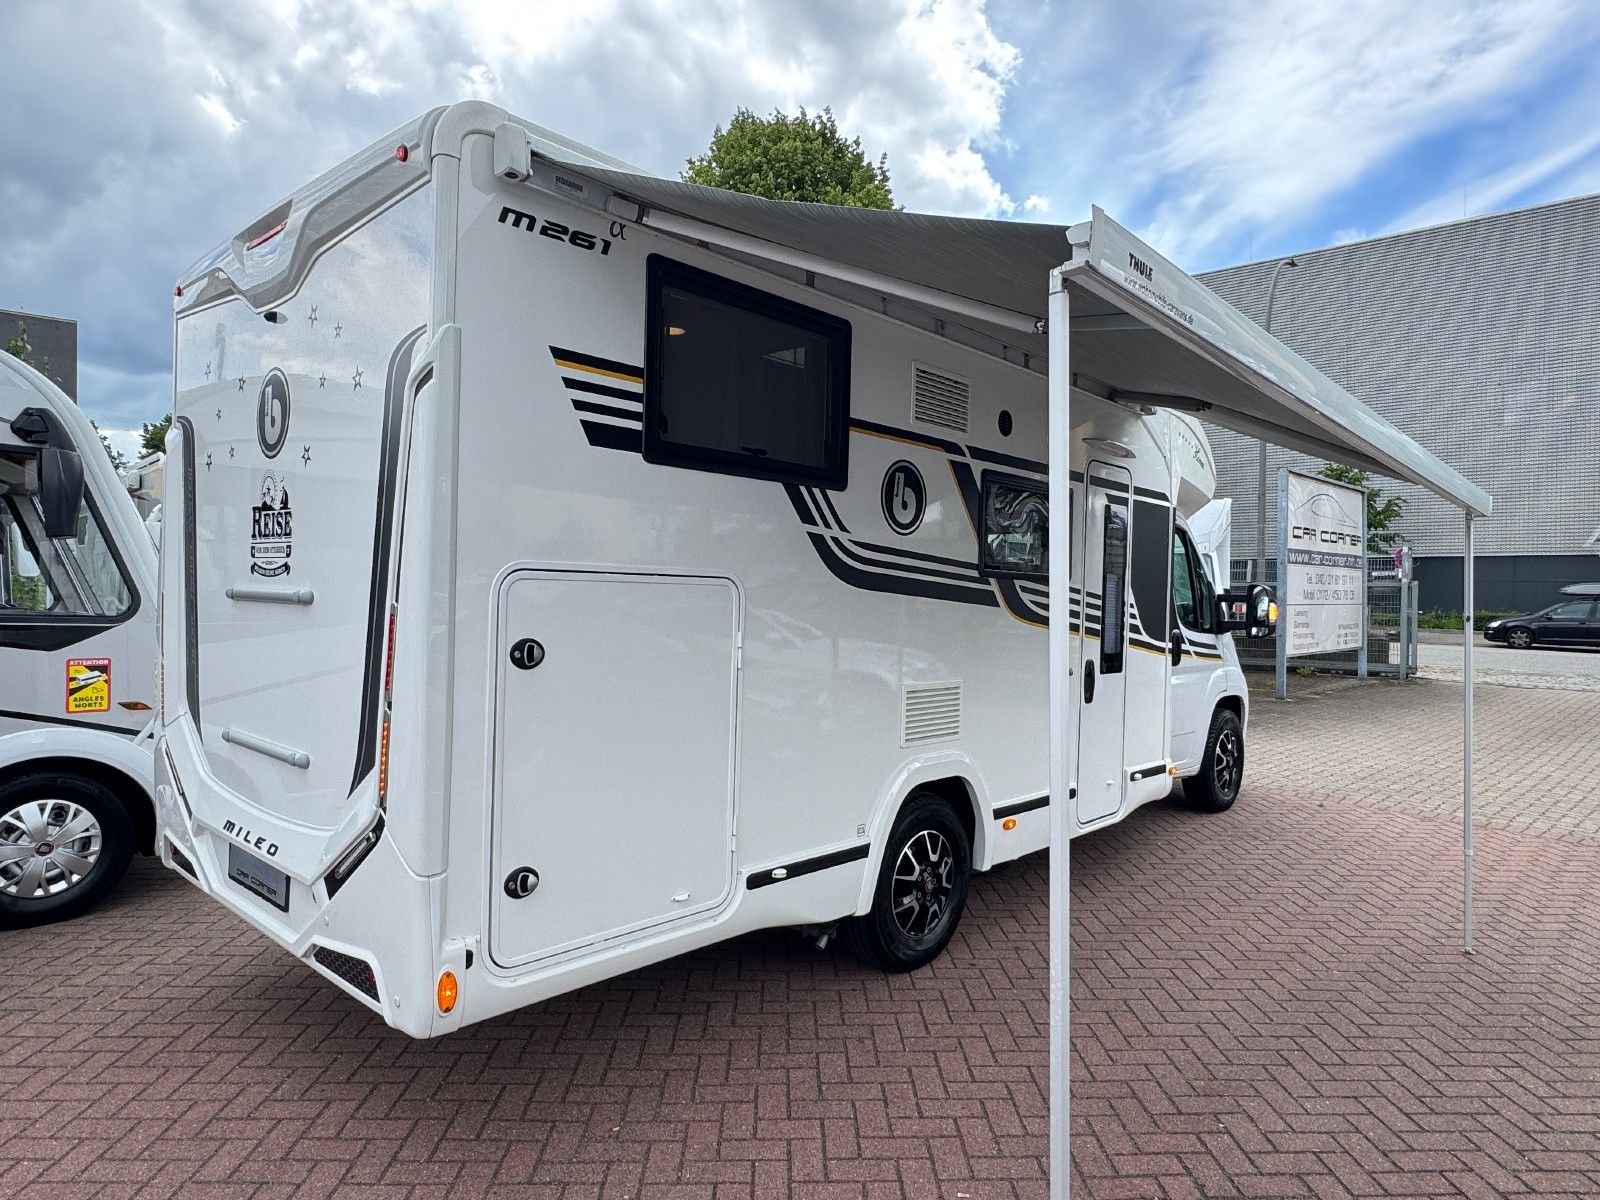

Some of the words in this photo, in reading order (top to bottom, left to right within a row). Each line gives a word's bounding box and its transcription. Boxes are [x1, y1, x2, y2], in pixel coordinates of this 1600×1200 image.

[1128, 251, 1154, 282] THULE
[251, 506, 292, 539] REISE
[1292, 525, 1317, 542] CAR
[72, 695, 105, 703] ANGLES
[222, 818, 279, 857] MILEO
